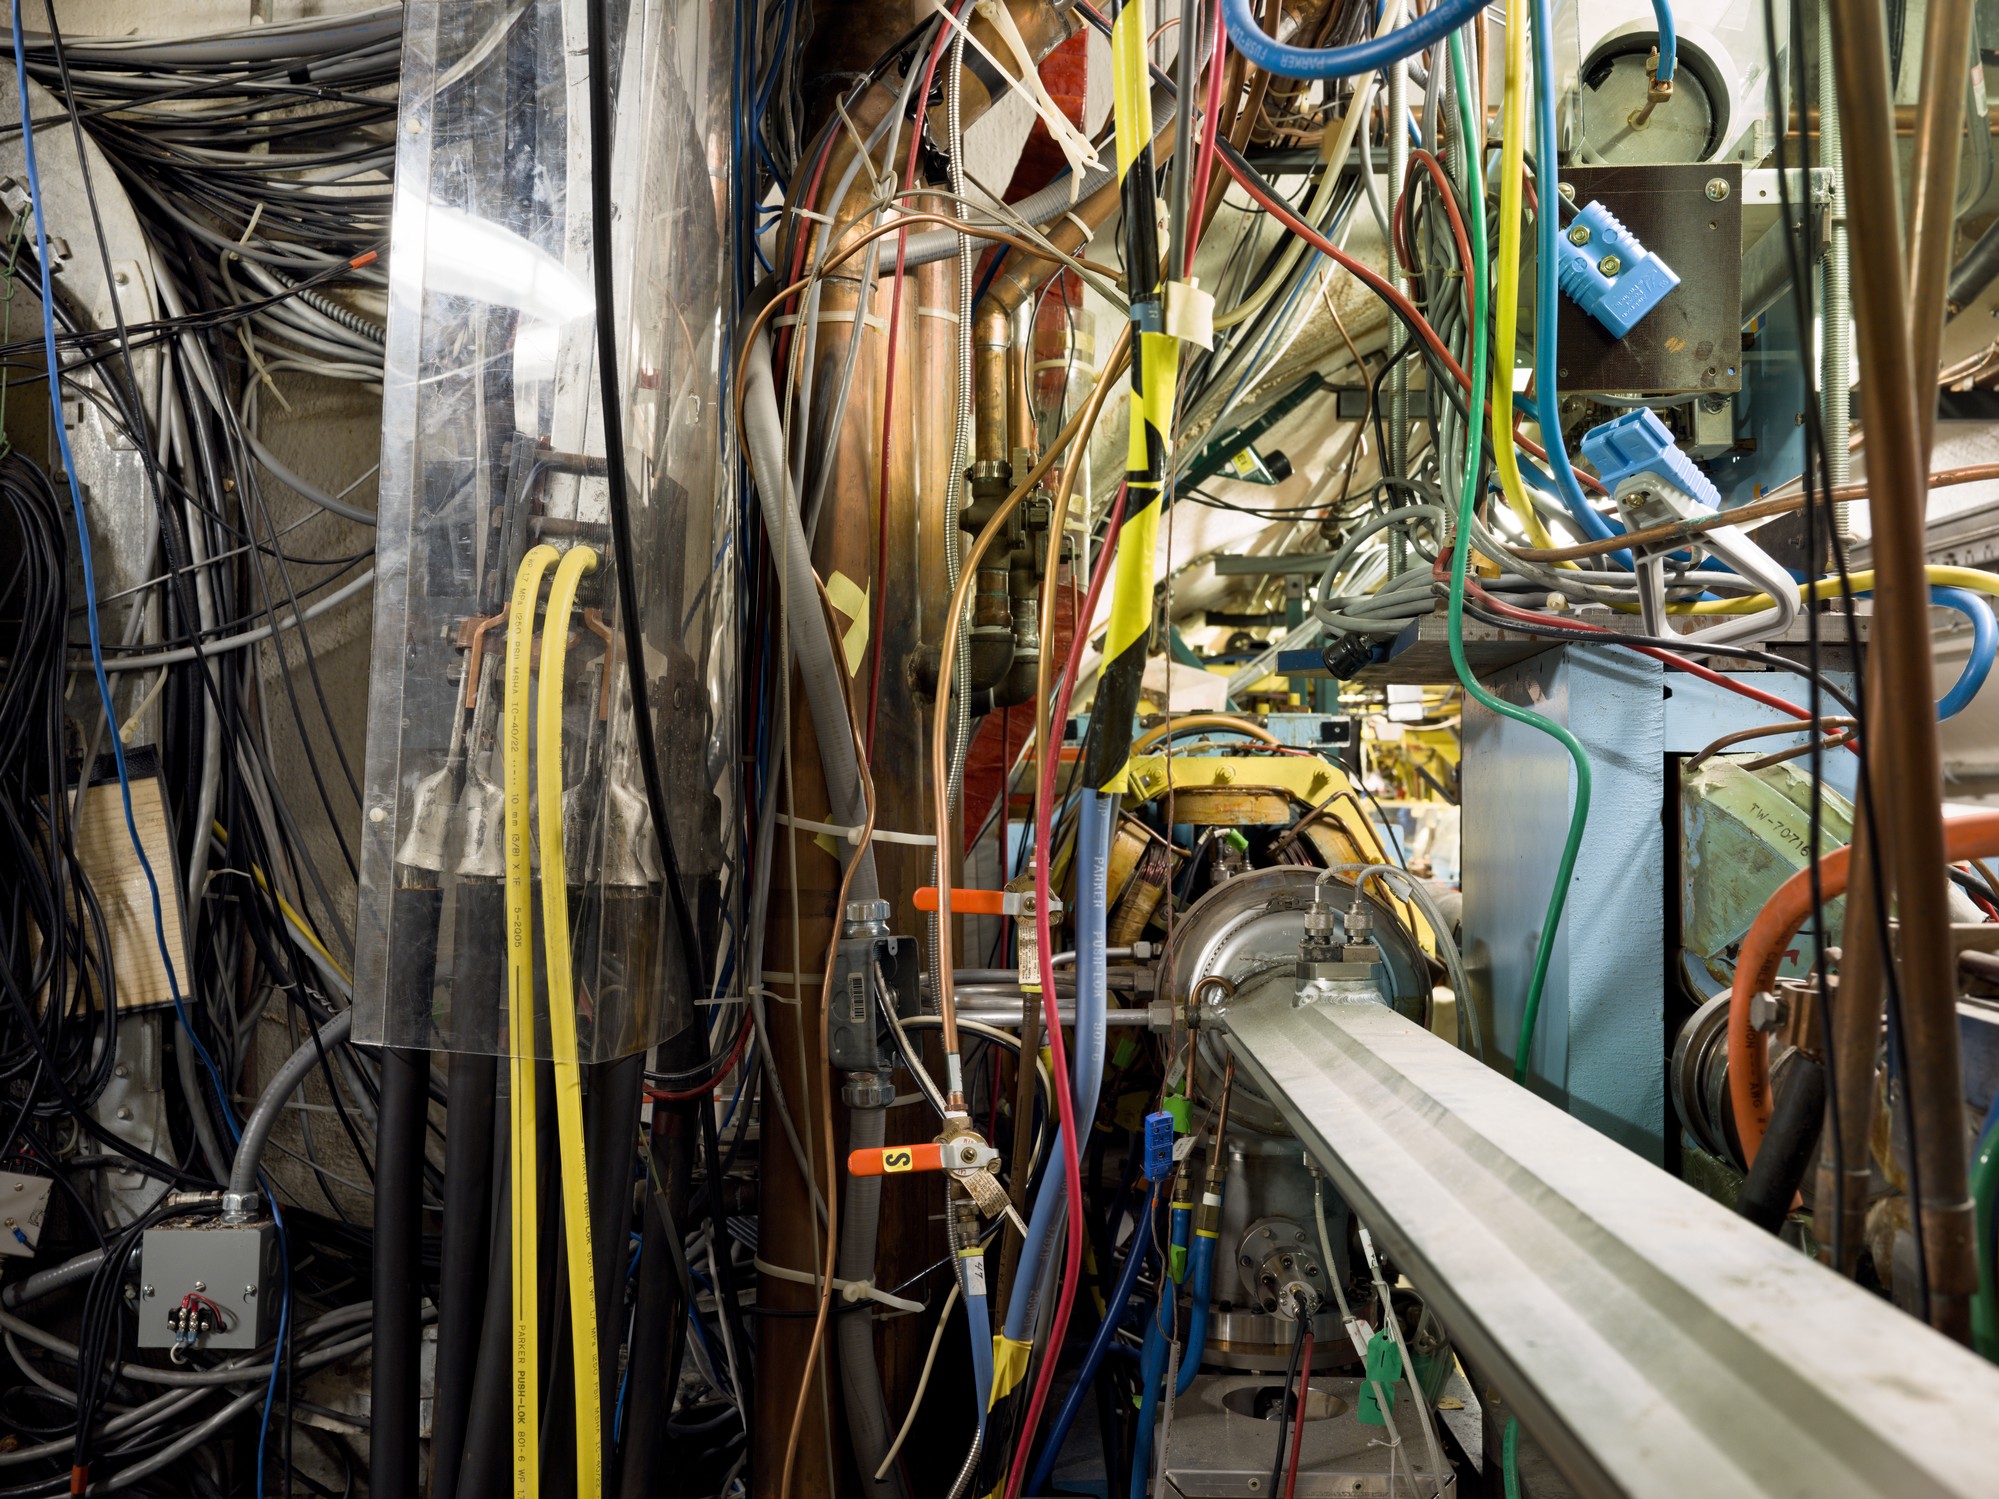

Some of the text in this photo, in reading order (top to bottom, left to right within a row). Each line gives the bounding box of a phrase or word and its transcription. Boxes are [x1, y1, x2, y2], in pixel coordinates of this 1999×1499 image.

[1280, 53, 1325, 70] PARKER
[512, 667, 520, 694] MSHA
[510, 702, 519, 753] IC-40/22
[512, 812, 518, 826] mm
[1094, 857, 1104, 908] PARKER
[1092, 931, 1103, 998] PUSH-LOK
[1755, 951, 1778, 986] CABLE
[1748, 1082, 1761, 1108] AWG
[885, 1152, 911, 1166] S
[518, 1325, 526, 1364] PARKER
[518, 1370, 526, 1424] PUSH-LOK
[518, 1469, 525, 1482] WP
